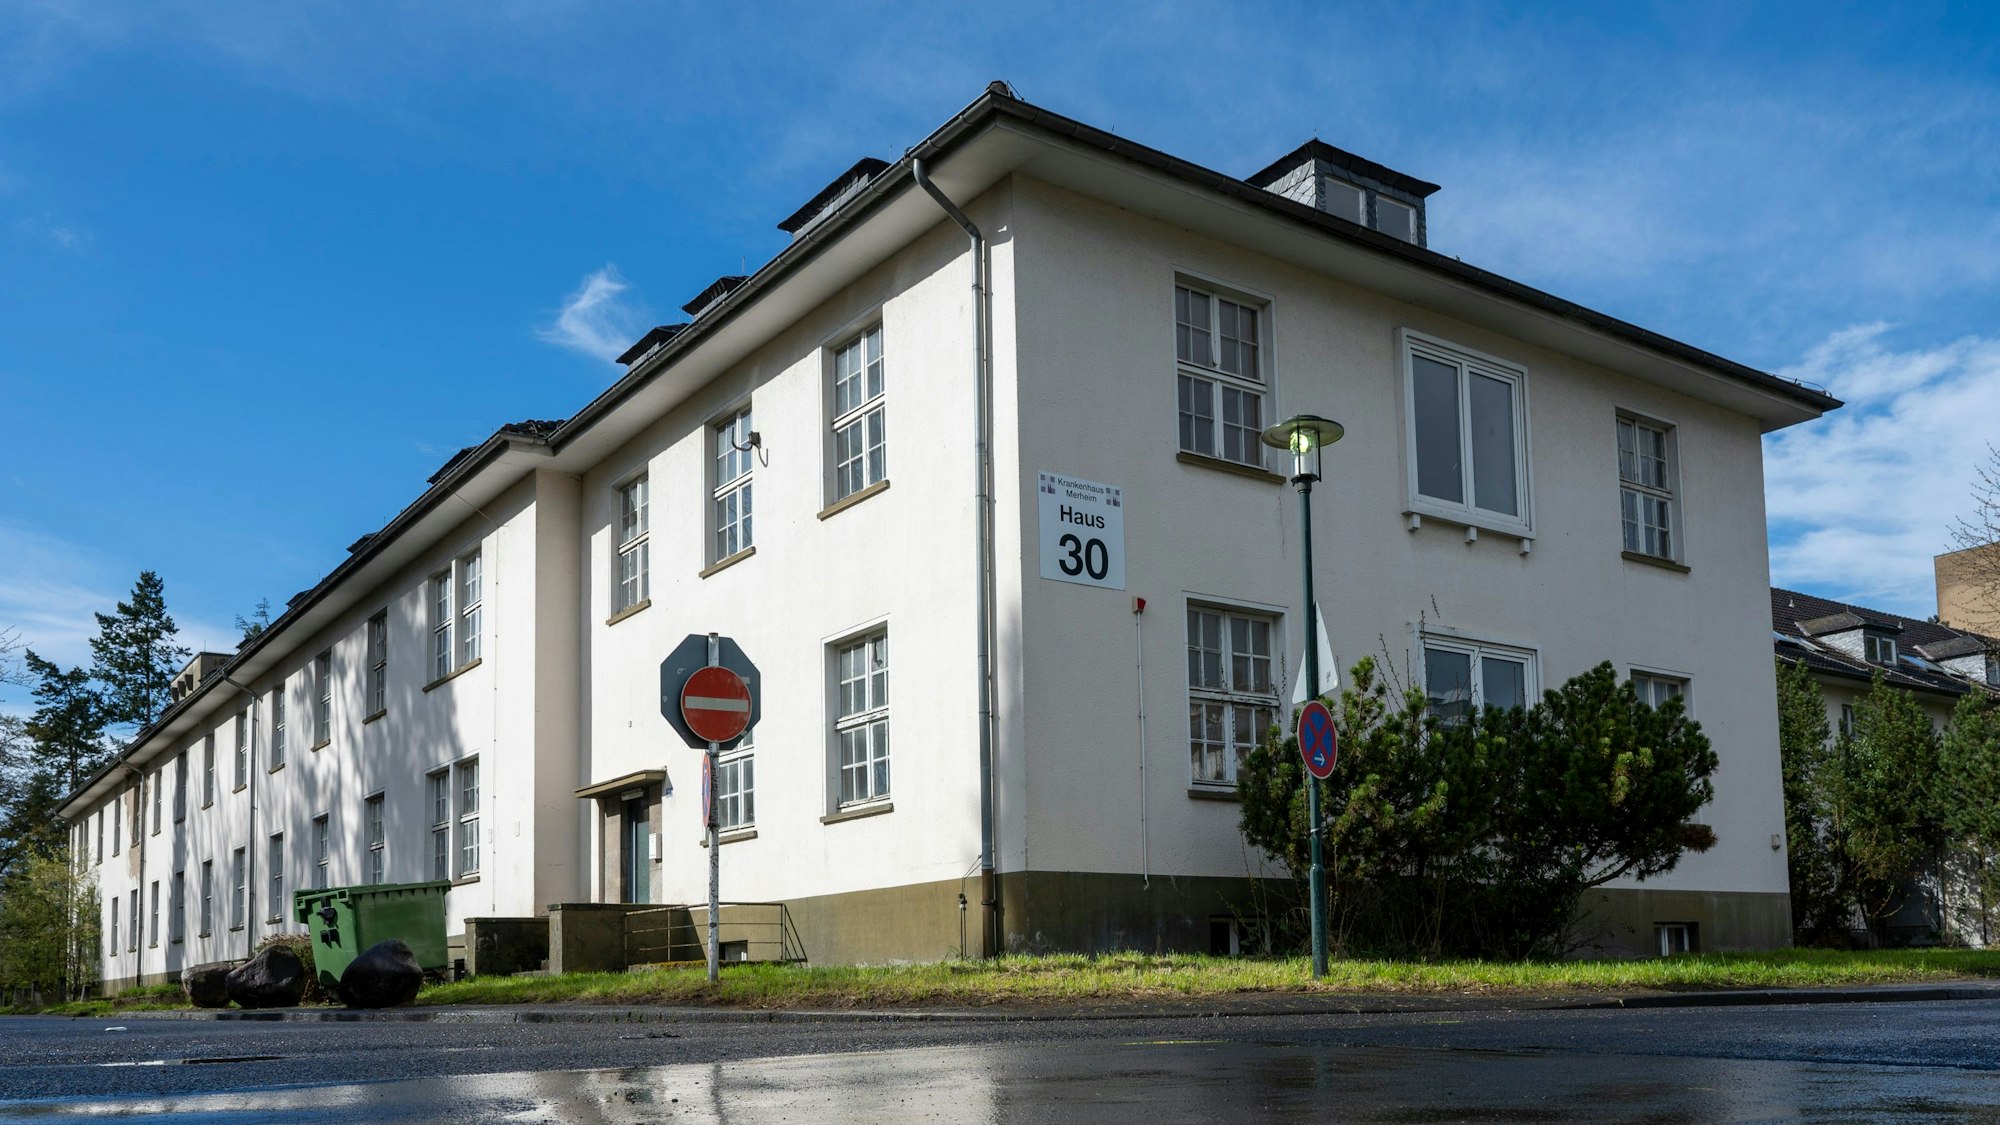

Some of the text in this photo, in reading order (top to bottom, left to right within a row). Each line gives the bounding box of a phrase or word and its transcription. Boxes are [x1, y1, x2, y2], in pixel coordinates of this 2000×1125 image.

[1058, 478, 1104, 494] Krankenhaus
[1066, 490, 1097, 502] Merheim
[1060, 504, 1105, 529] Haus
[1059, 533, 1109, 580] 30
